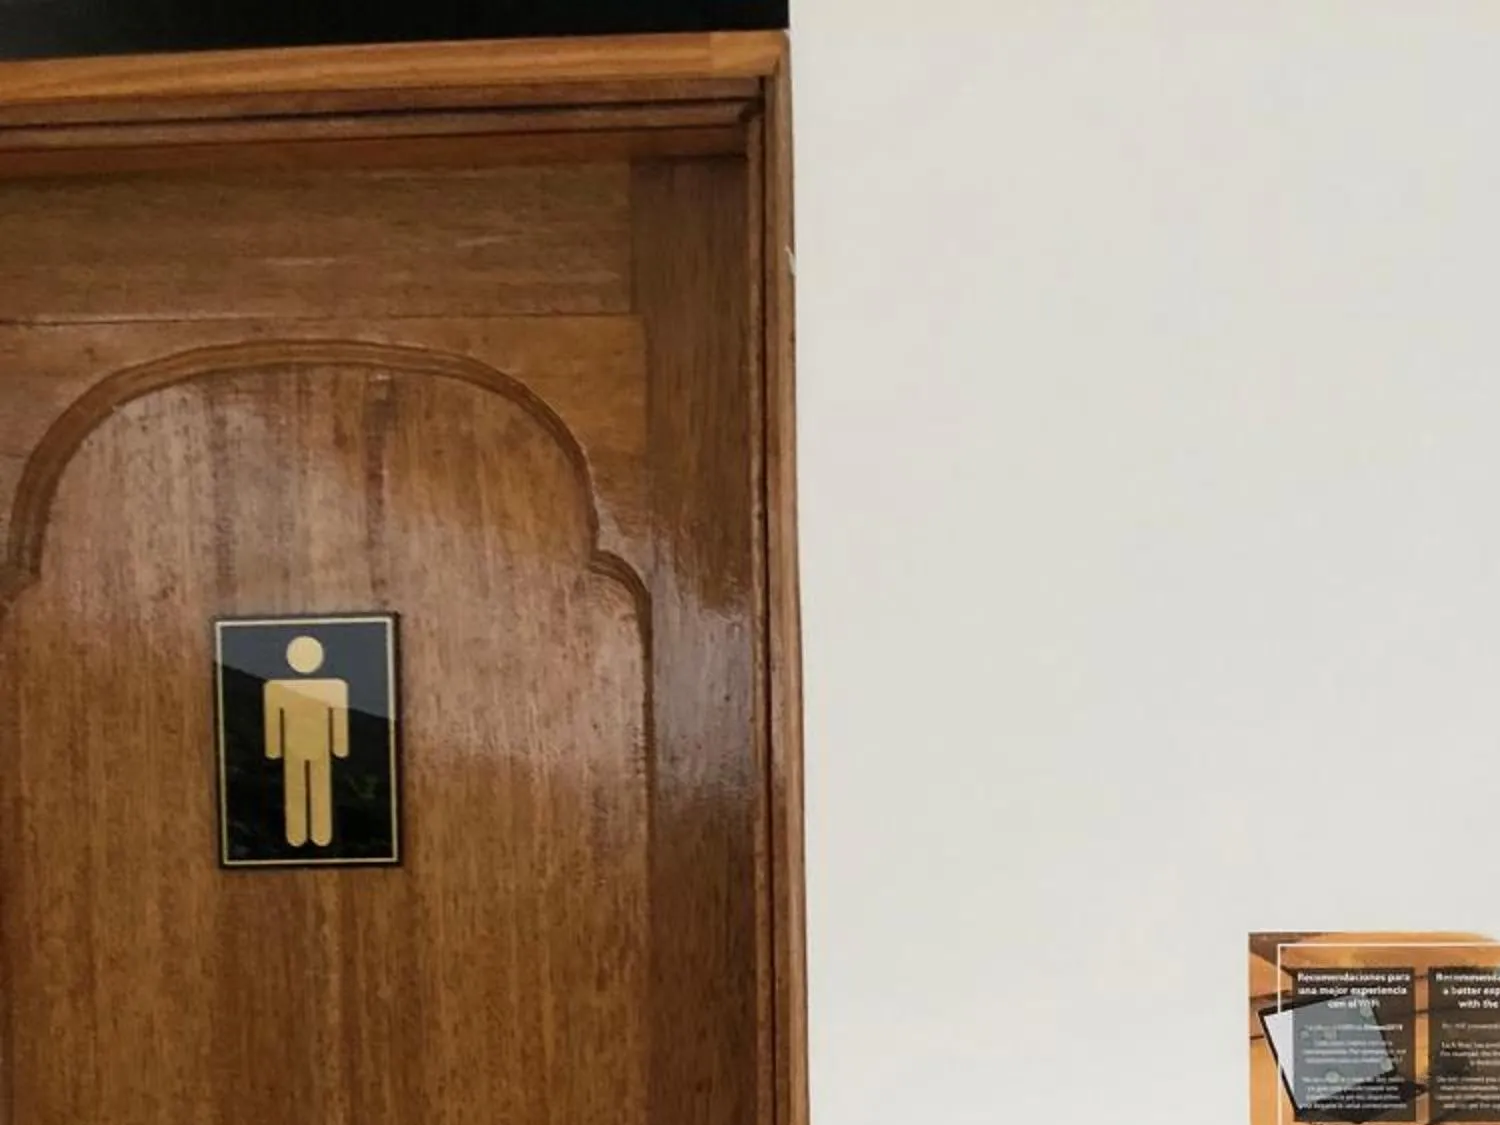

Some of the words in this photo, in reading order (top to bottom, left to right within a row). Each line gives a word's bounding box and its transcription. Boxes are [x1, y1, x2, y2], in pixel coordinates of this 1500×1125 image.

[1297, 972, 1386, 983] Recomendaciones
[1387, 974, 1411, 983] para
[1319, 986, 1349, 997] mejor
[1350, 986, 1407, 997] experiencia
[1451, 986, 1482, 995] better
[1458, 999, 1481, 1009] with
[1482, 999, 1499, 1009] the
